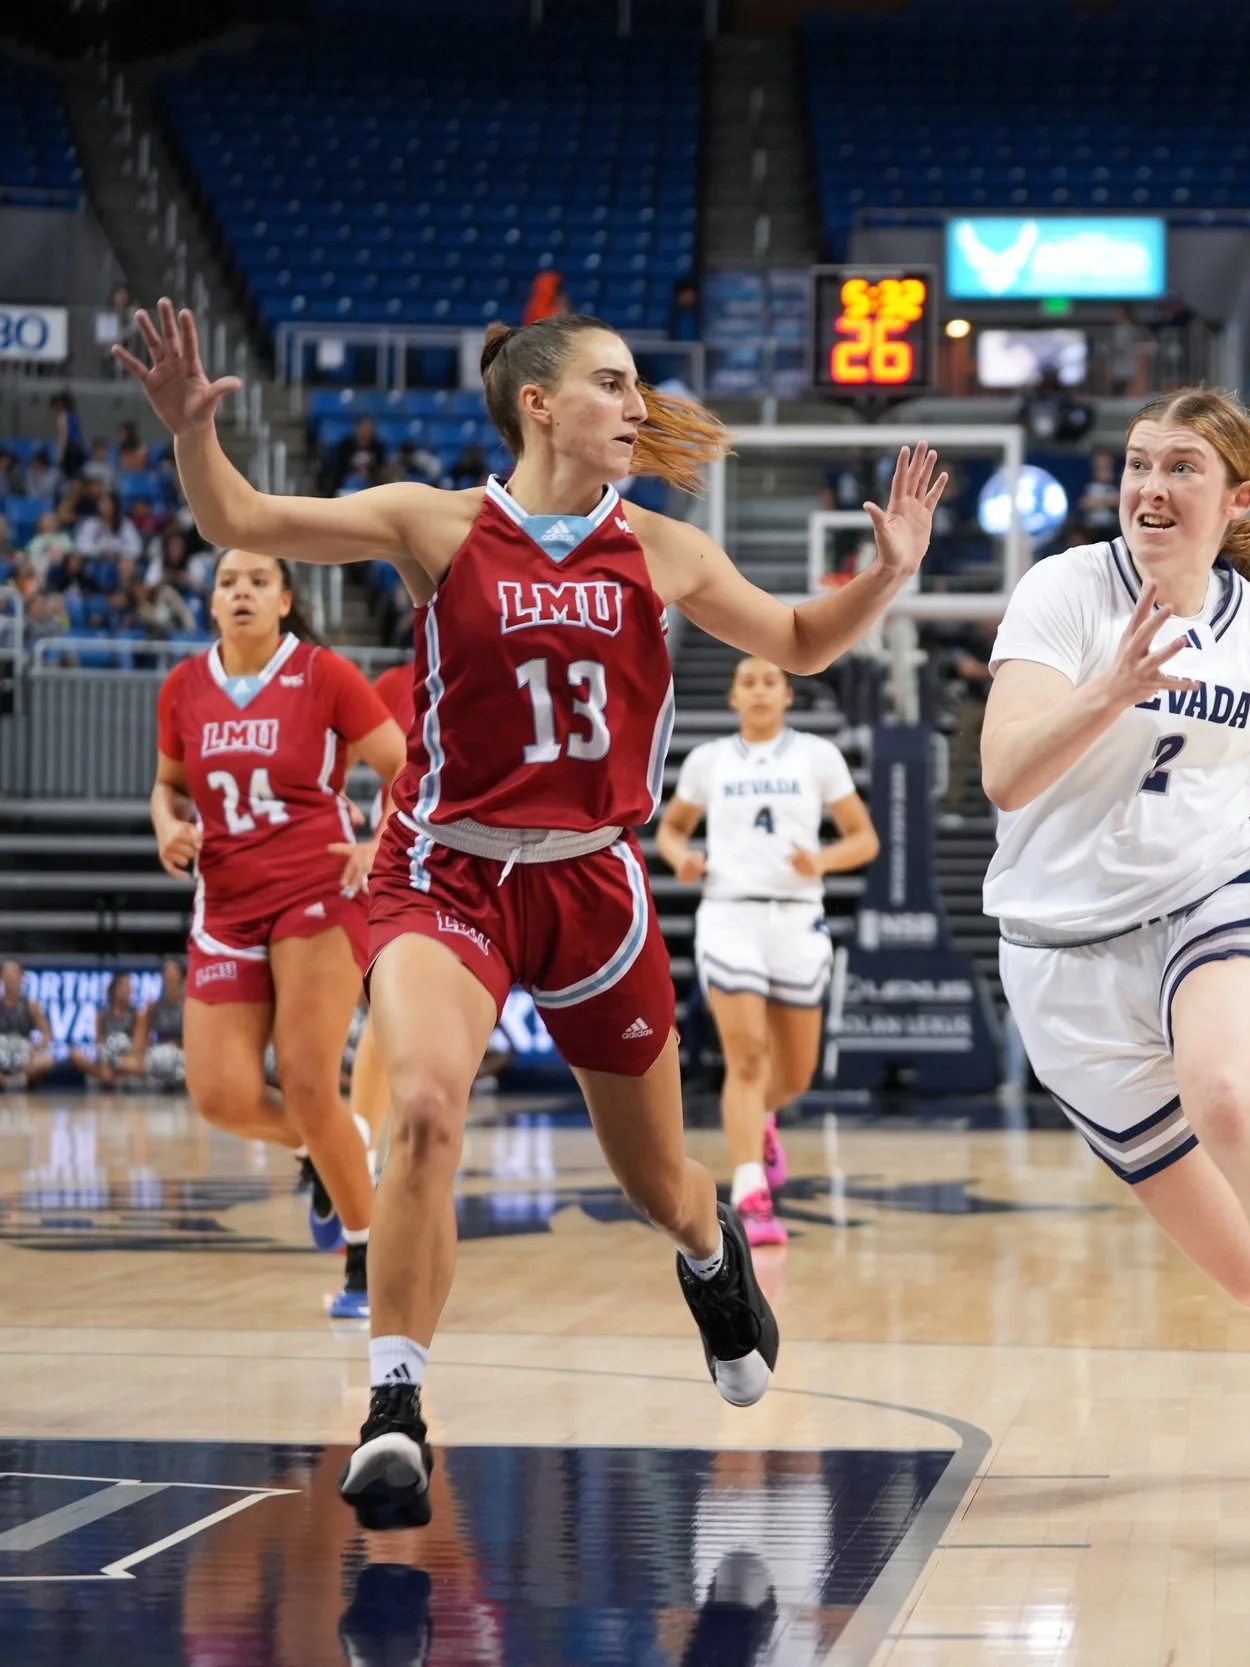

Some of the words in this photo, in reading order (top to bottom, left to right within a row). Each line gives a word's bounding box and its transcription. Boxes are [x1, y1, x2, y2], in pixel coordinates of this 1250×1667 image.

[831, 317, 913, 384] 26
[498, 581, 622, 637] LMU
[202, 719, 280, 757] LMU
[515, 658, 611, 764] 13
[724, 778, 802, 797] NEVADA
[1135, 732, 1188, 796] 2
[207, 768, 290, 836] 24
[754, 806, 775, 834] 4
[621, 1027, 654, 1040] adidas
